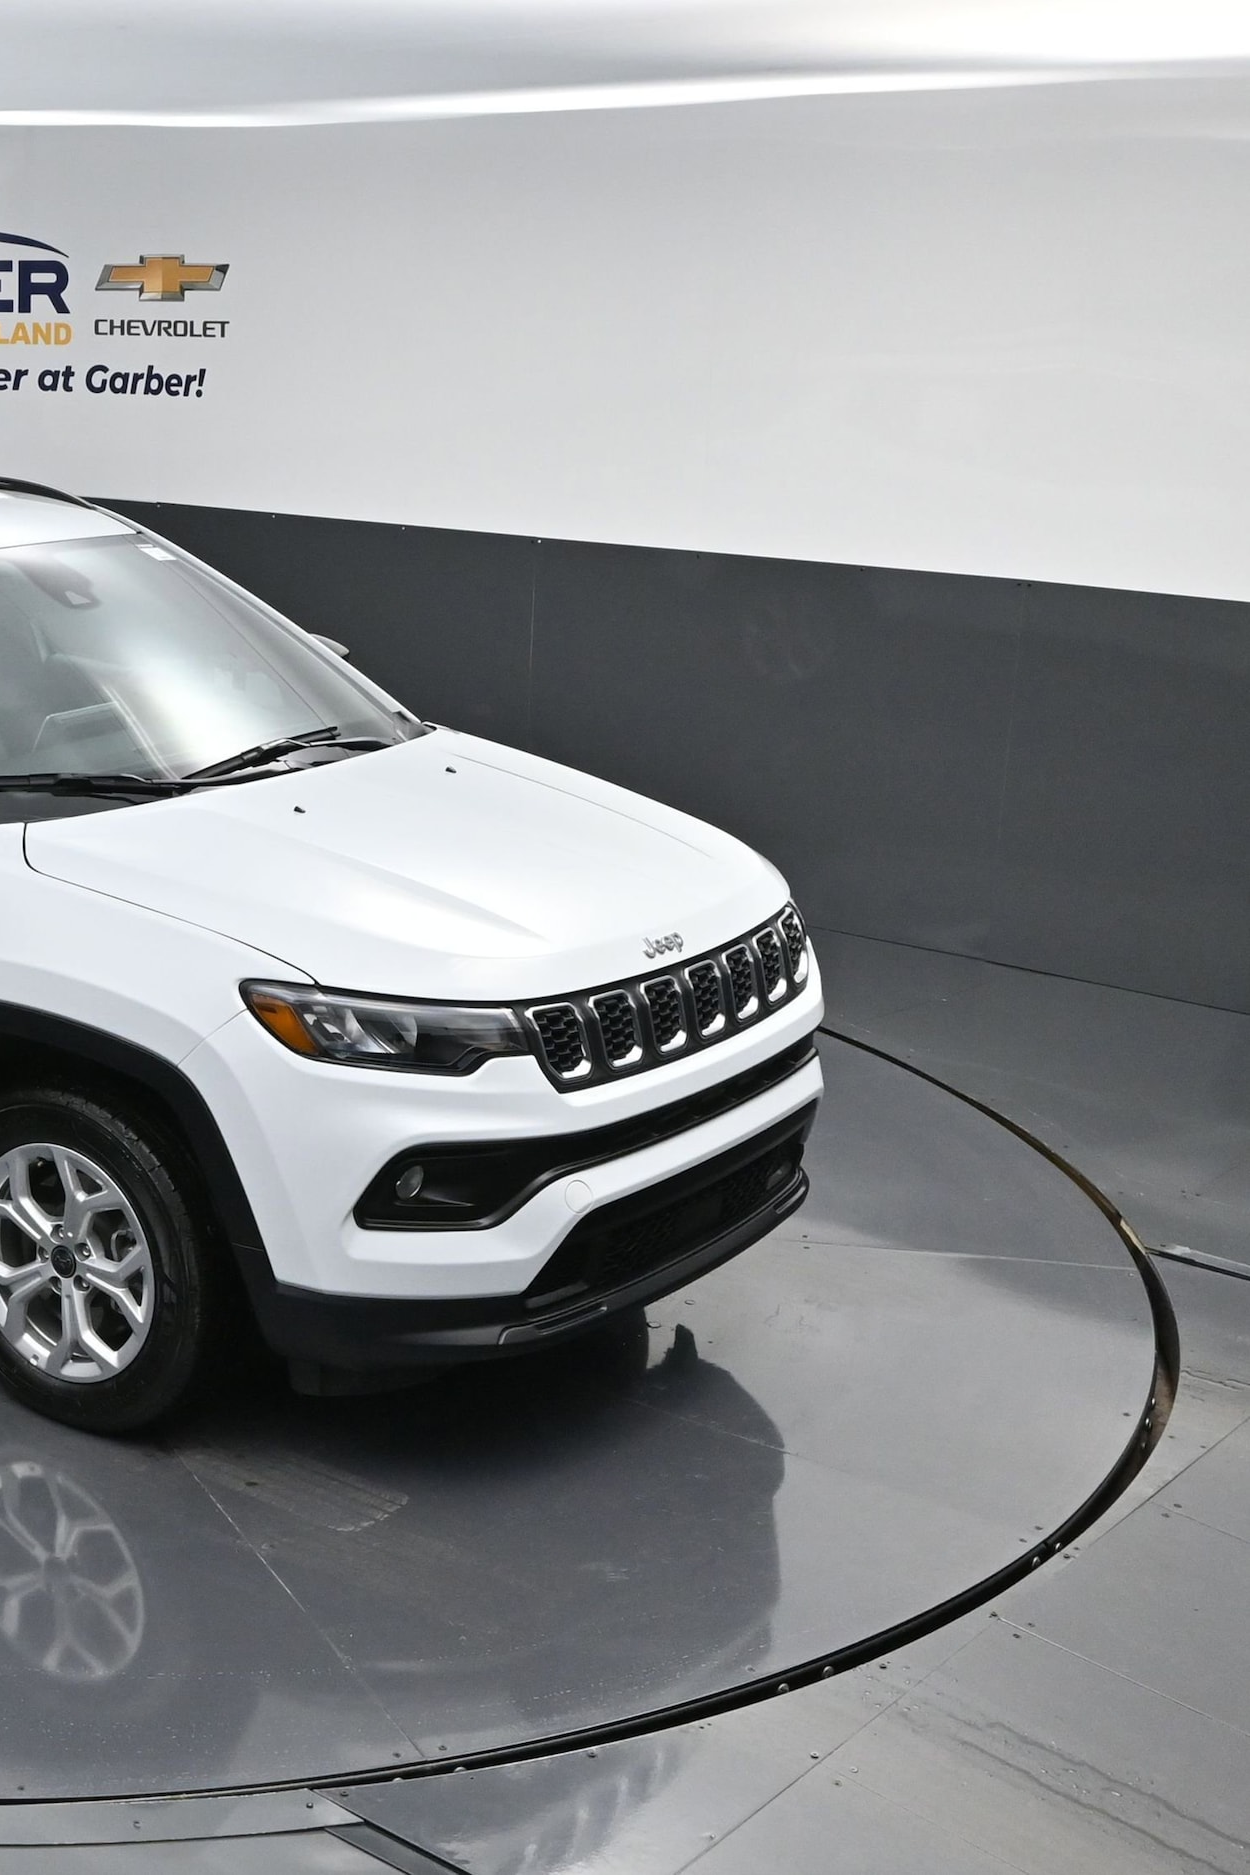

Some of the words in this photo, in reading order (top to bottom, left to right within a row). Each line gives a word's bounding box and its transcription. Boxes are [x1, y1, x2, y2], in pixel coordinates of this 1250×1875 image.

[94, 319, 230, 338] CHEVROLET
[38, 366, 75, 392] at
[86, 365, 206, 398] Garber!
[642, 932, 684, 959] Jeep
